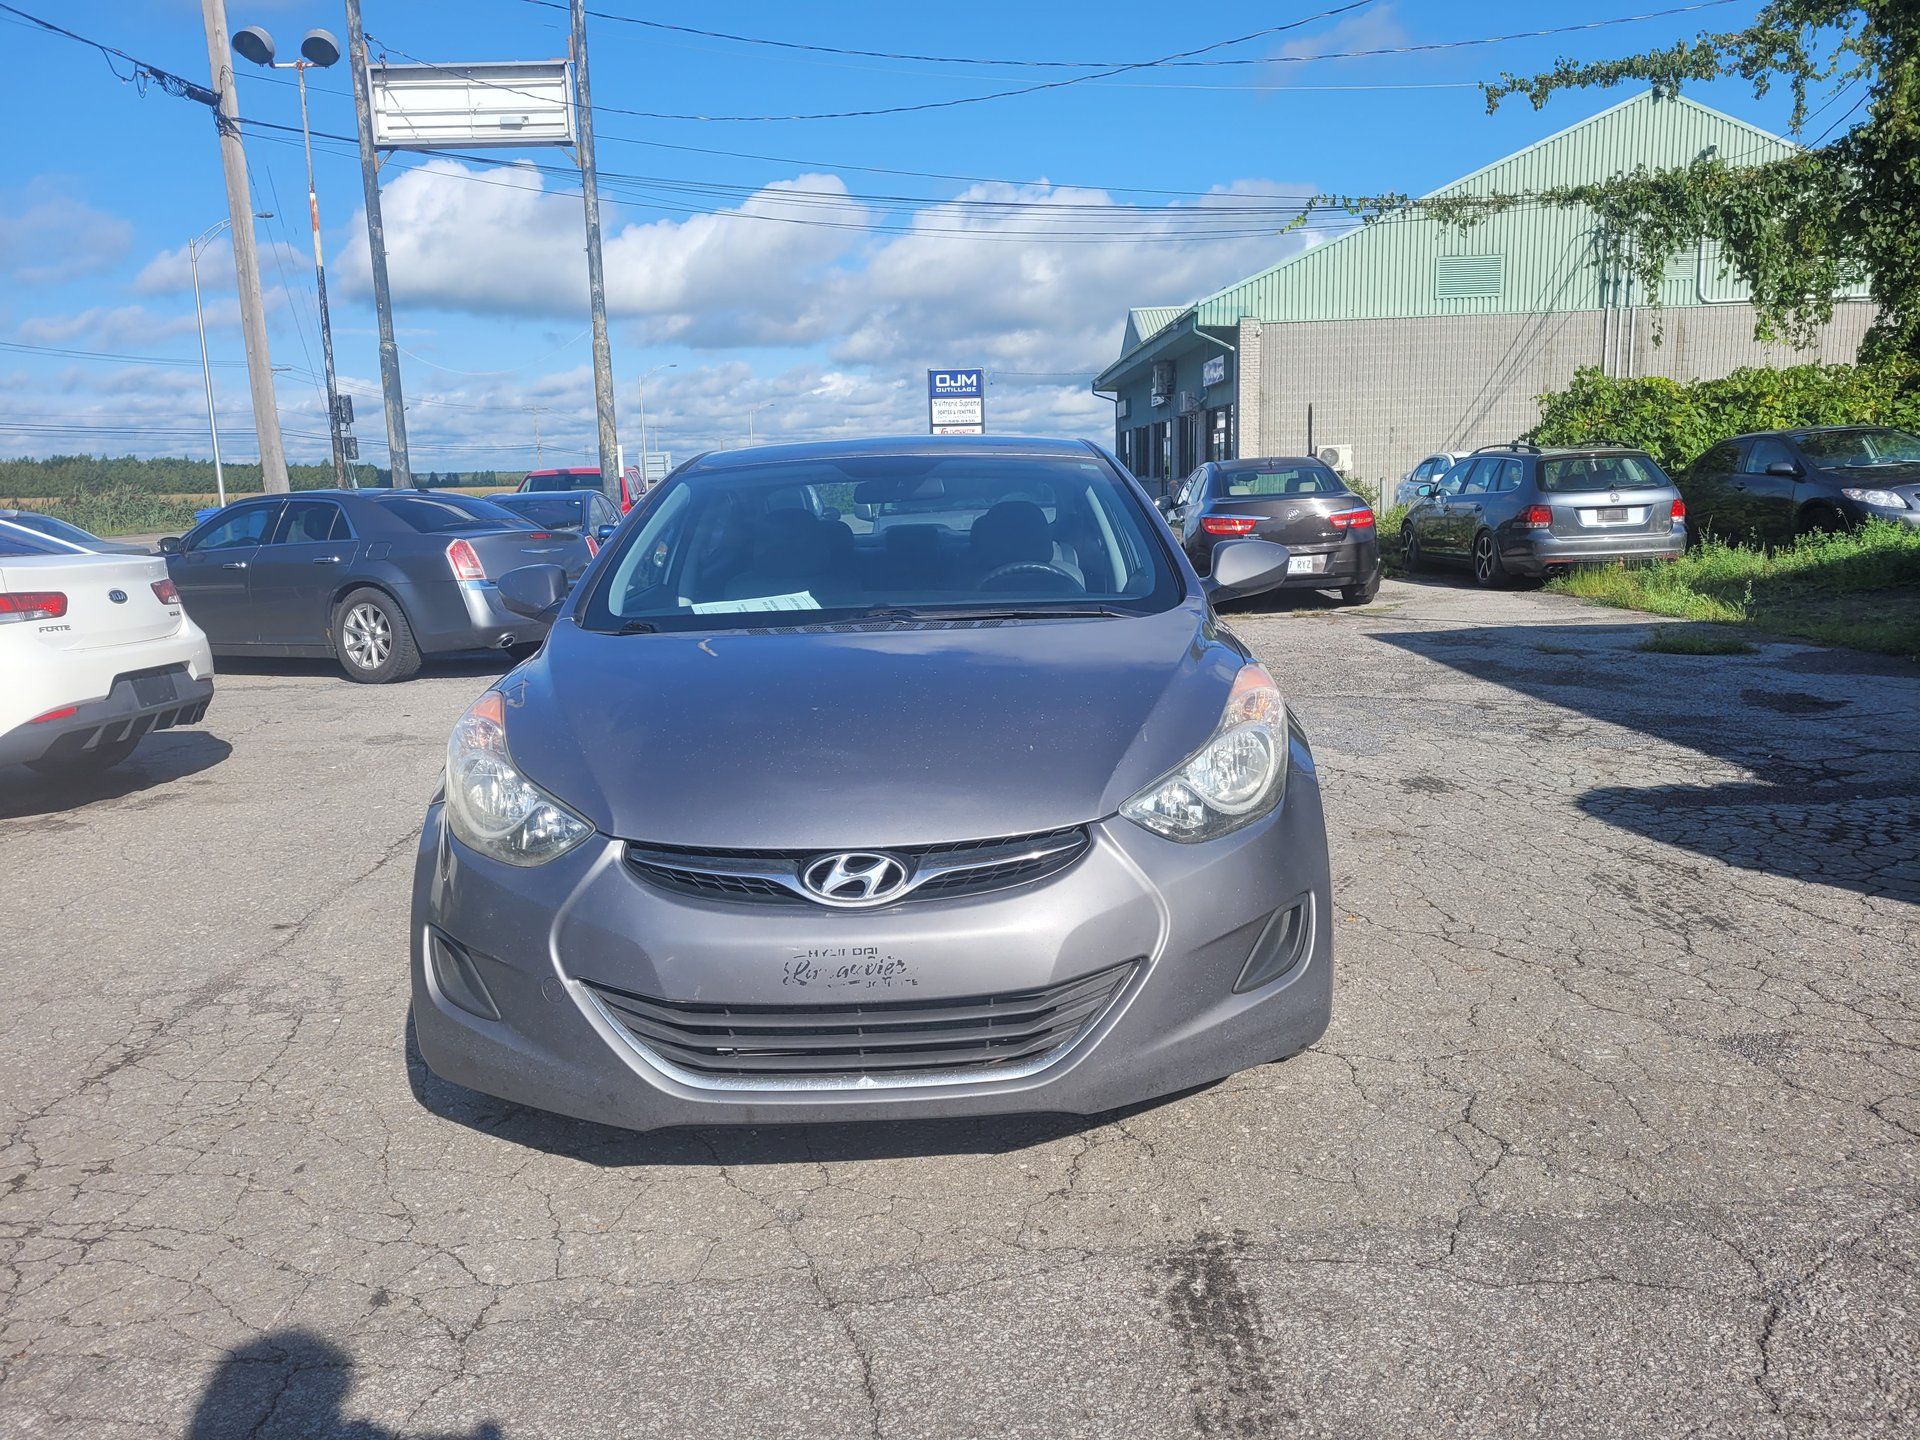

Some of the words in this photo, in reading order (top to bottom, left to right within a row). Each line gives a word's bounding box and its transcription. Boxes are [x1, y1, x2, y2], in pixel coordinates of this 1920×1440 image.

[936, 374, 977, 387] OJM
[1297, 560, 1311, 569] RYZ
[39, 624, 72, 633] FORTE
